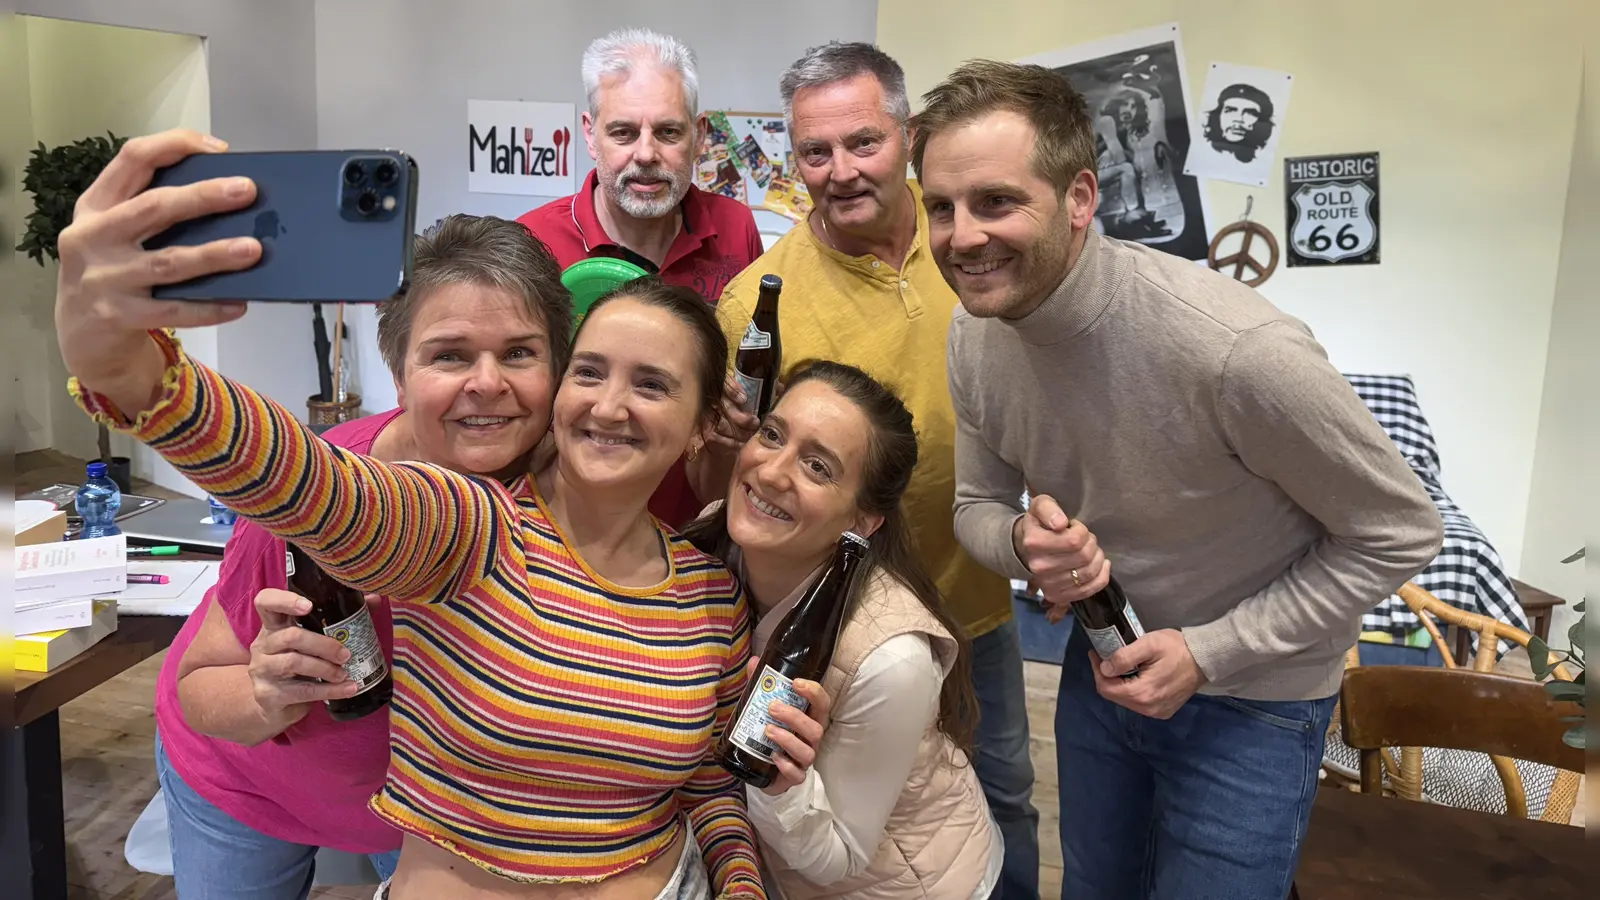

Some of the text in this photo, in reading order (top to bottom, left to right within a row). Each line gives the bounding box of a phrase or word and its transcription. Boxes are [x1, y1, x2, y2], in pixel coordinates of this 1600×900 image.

[1290, 158, 1375, 178] HISTORIC
[1313, 191, 1352, 206] OLD
[1307, 206, 1359, 220] ROUTE
[1307, 223, 1360, 252] 66
